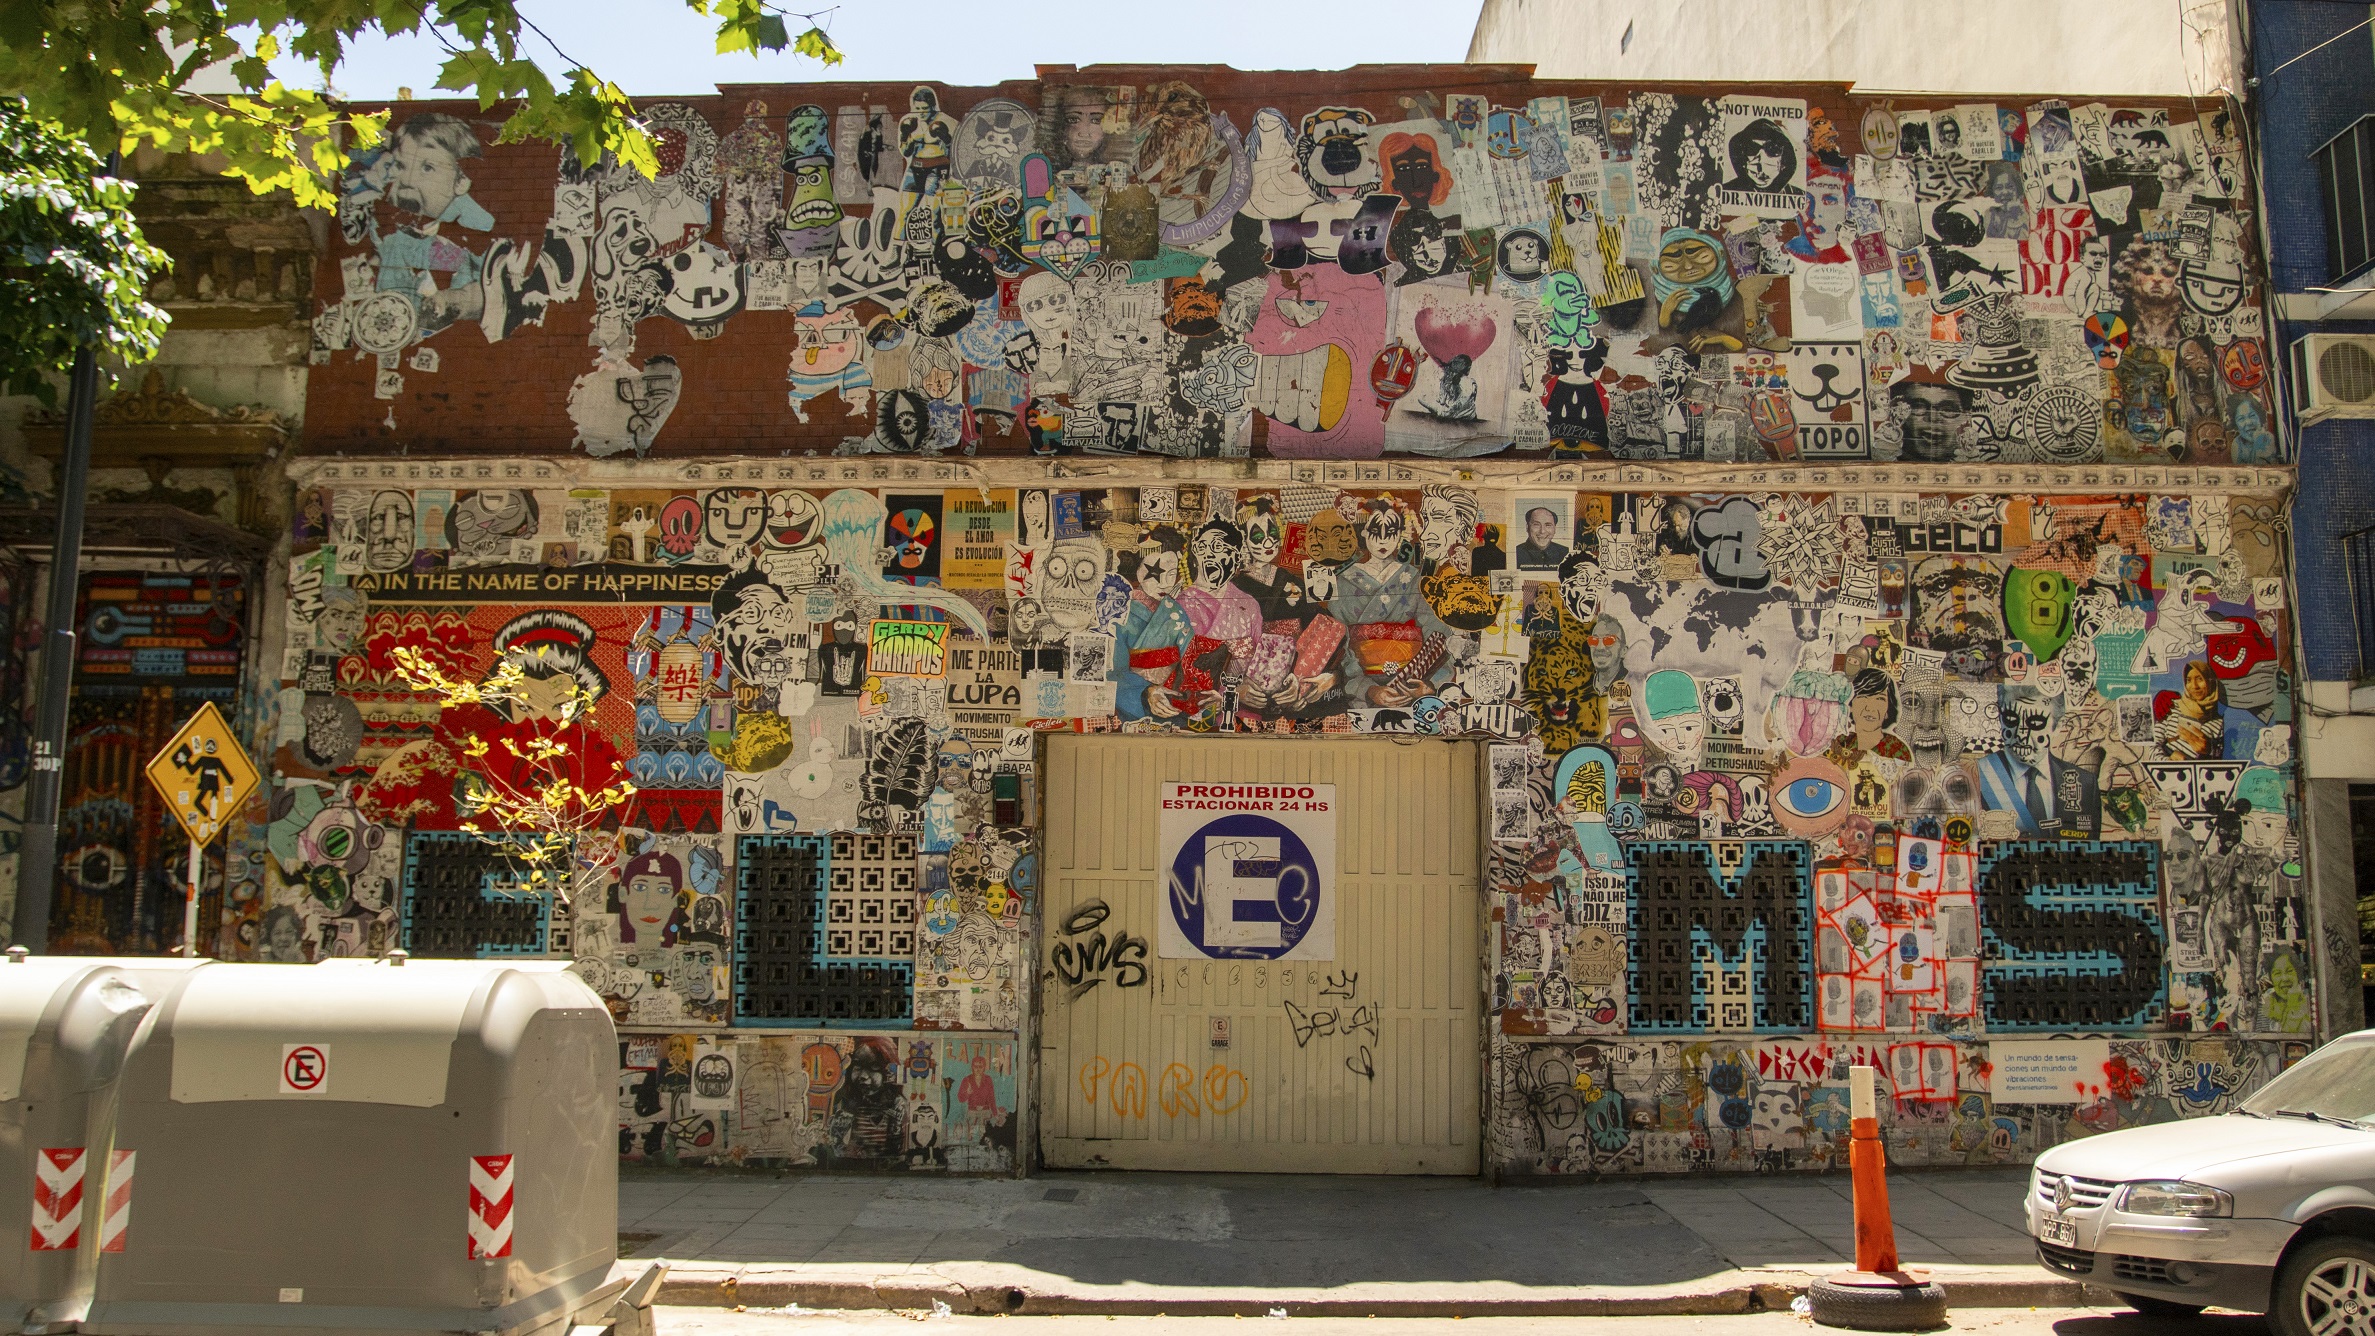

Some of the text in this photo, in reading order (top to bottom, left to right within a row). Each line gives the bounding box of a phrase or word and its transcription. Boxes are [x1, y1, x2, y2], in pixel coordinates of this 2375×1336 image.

[1725, 103, 1803, 119] NOT WANTED
[911, 206, 932, 221] STOP
[2038, 386, 2090, 404] CHOSEN
[1798, 426, 1860, 450] TOPO
[953, 501, 963, 514] LA
[1922, 497, 1946, 511] PINTO
[969, 516, 991, 530] DESDE
[964, 531, 994, 543] EL AMOR
[1871, 536, 1897, 548] RUSTY
[954, 545, 1003, 560] ES EVOLUCIÓN
[1866, 545, 1902, 557] DEIMOS
[384, 573, 727, 592] IN THE NAME OF HAPPINESS
[1837, 595, 1878, 611] HARVJAZZ
[874, 622, 947, 646] GERDY
[871, 634, 945, 676] HARAPOS
[951, 649, 1020, 672] ME PARTE
[974, 673, 995, 684] LA
[947, 683, 1022, 705] LUPA
[954, 712, 1012, 724] MOVIMIENTO
[996, 762, 1033, 774] #BAPA
[1705, 757, 1766, 771] PETRUSHAUS
[1176, 785, 1315, 800] PROHIBIDO
[1162, 799, 1329, 813] ESTACIONAR 24 HS
[1873, 803, 1888, 811] YOU
[2060, 830, 2090, 839] GERDY
[987, 869, 1005, 880] 2144
[1582, 889, 1626, 903] NÃO LHE
[1583, 903, 1611, 922] DIZ
[946, 1041, 1012, 1076] LATIN
[2004, 1054, 2015, 1062] Un
[2016, 1054, 2043, 1062] mundo
[2044, 1054, 2054, 1062] de
[293, 1054, 315, 1082] E
[2004, 1065, 2029, 1073] ciones
[2030, 1065, 2040, 1073] un
[2041, 1065, 2067, 1073] mundo
[2005, 1075, 2047, 1083] vibraciones
